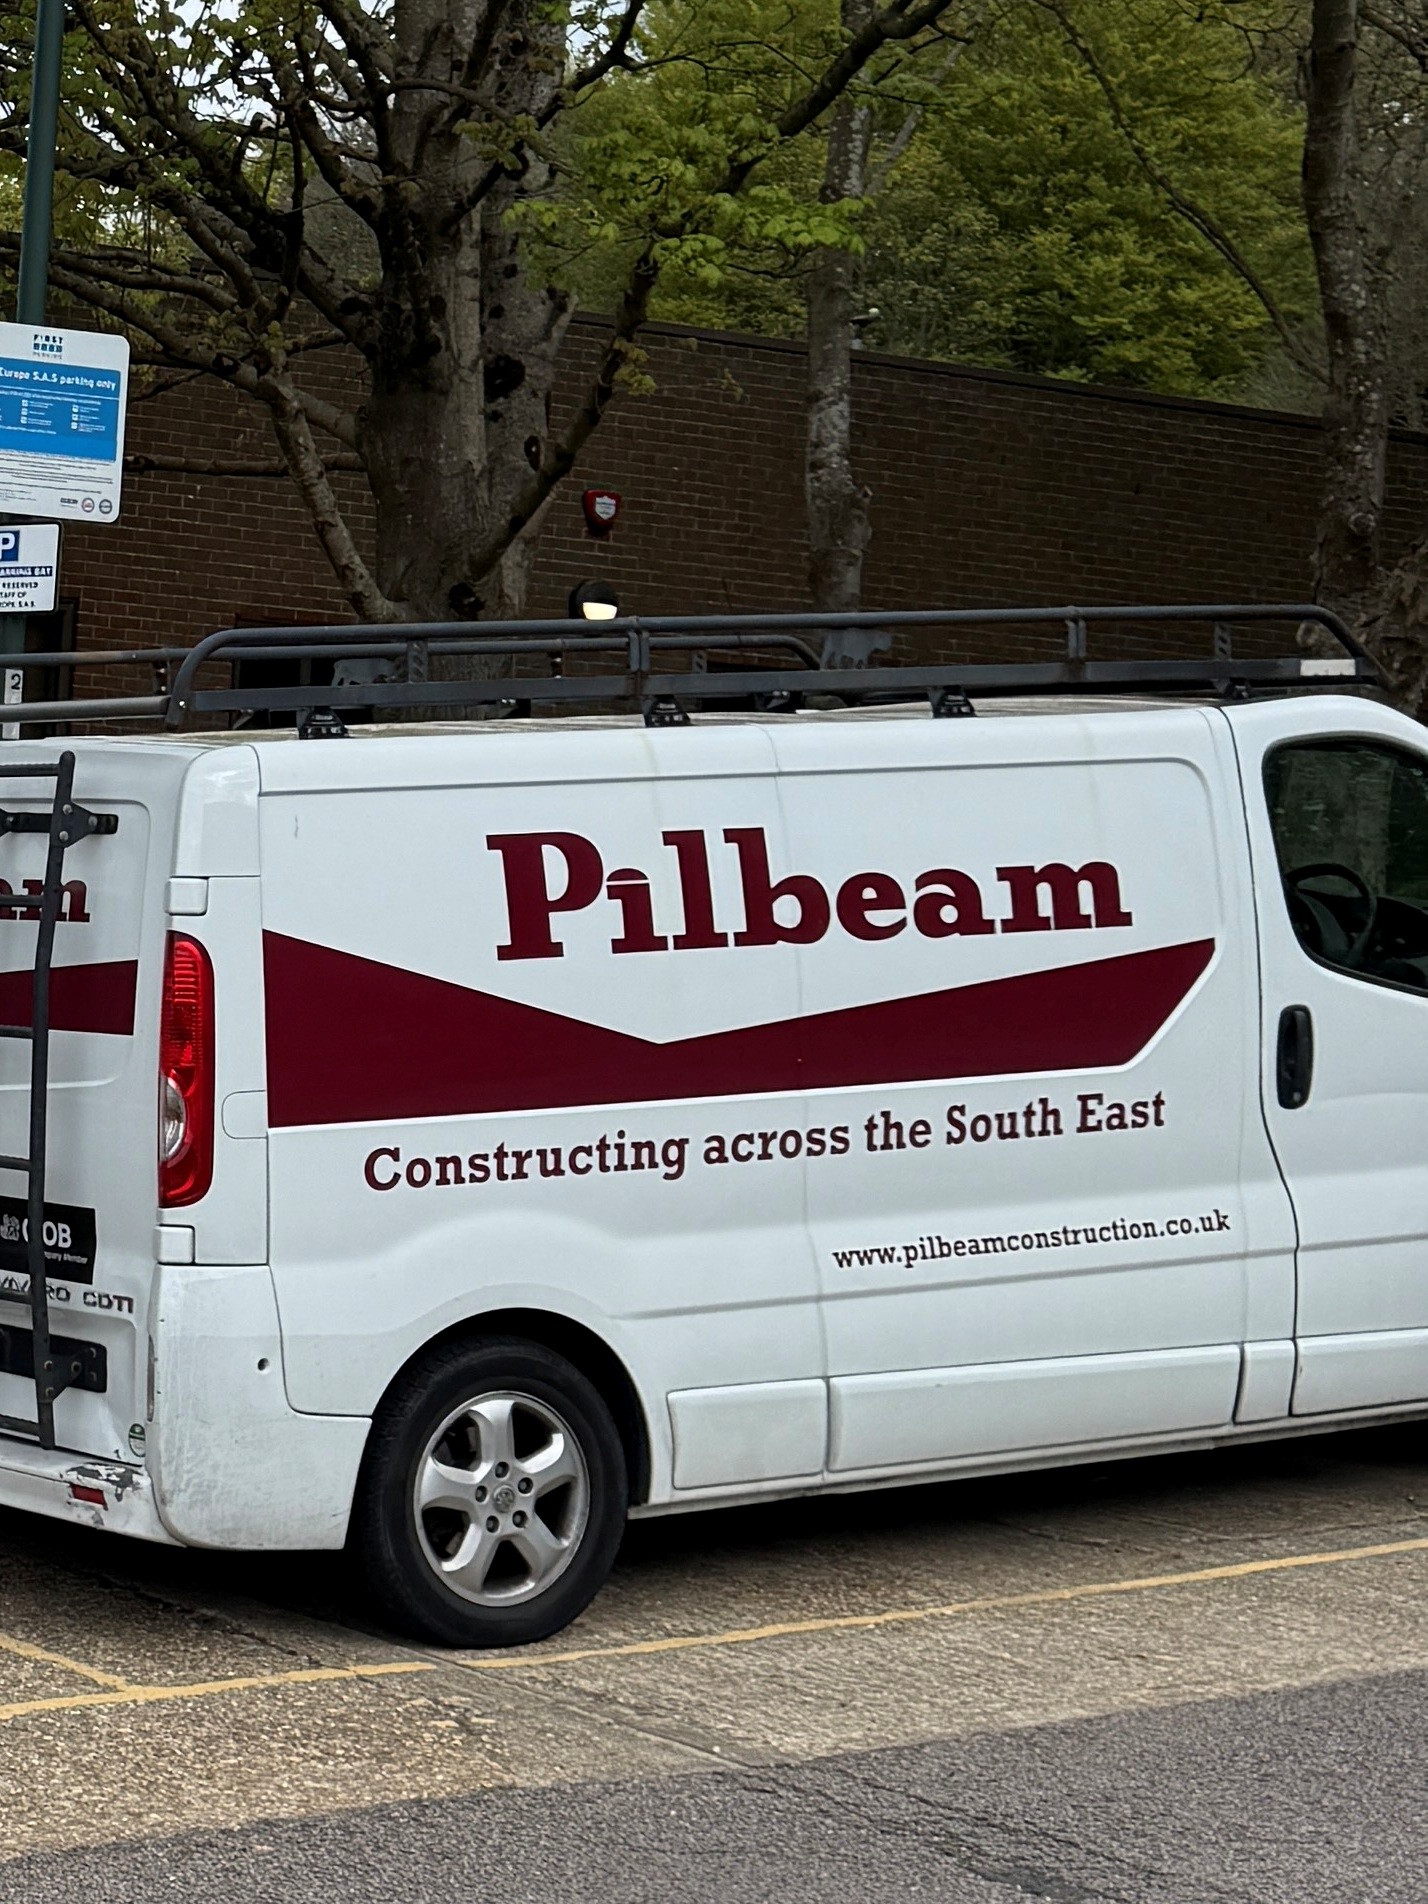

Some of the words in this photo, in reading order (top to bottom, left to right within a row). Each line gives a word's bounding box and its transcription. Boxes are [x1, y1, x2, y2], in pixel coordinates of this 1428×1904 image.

[60, 375, 94, 389] parking
[96, 379, 117, 392] only
[11, 673, 21, 690] 2
[486, 825, 1133, 962] Pilbeam
[364, 1130, 690, 1193] Constructing
[702, 1122, 851, 1166] across
[863, 1109, 933, 1153] the
[945, 1100, 1063, 1146] South
[1076, 1090, 1167, 1136] East
[833, 1207, 1232, 1271] www.pilbeamconstruction.co.uk
[83, 1290, 134, 1314] CDTI
